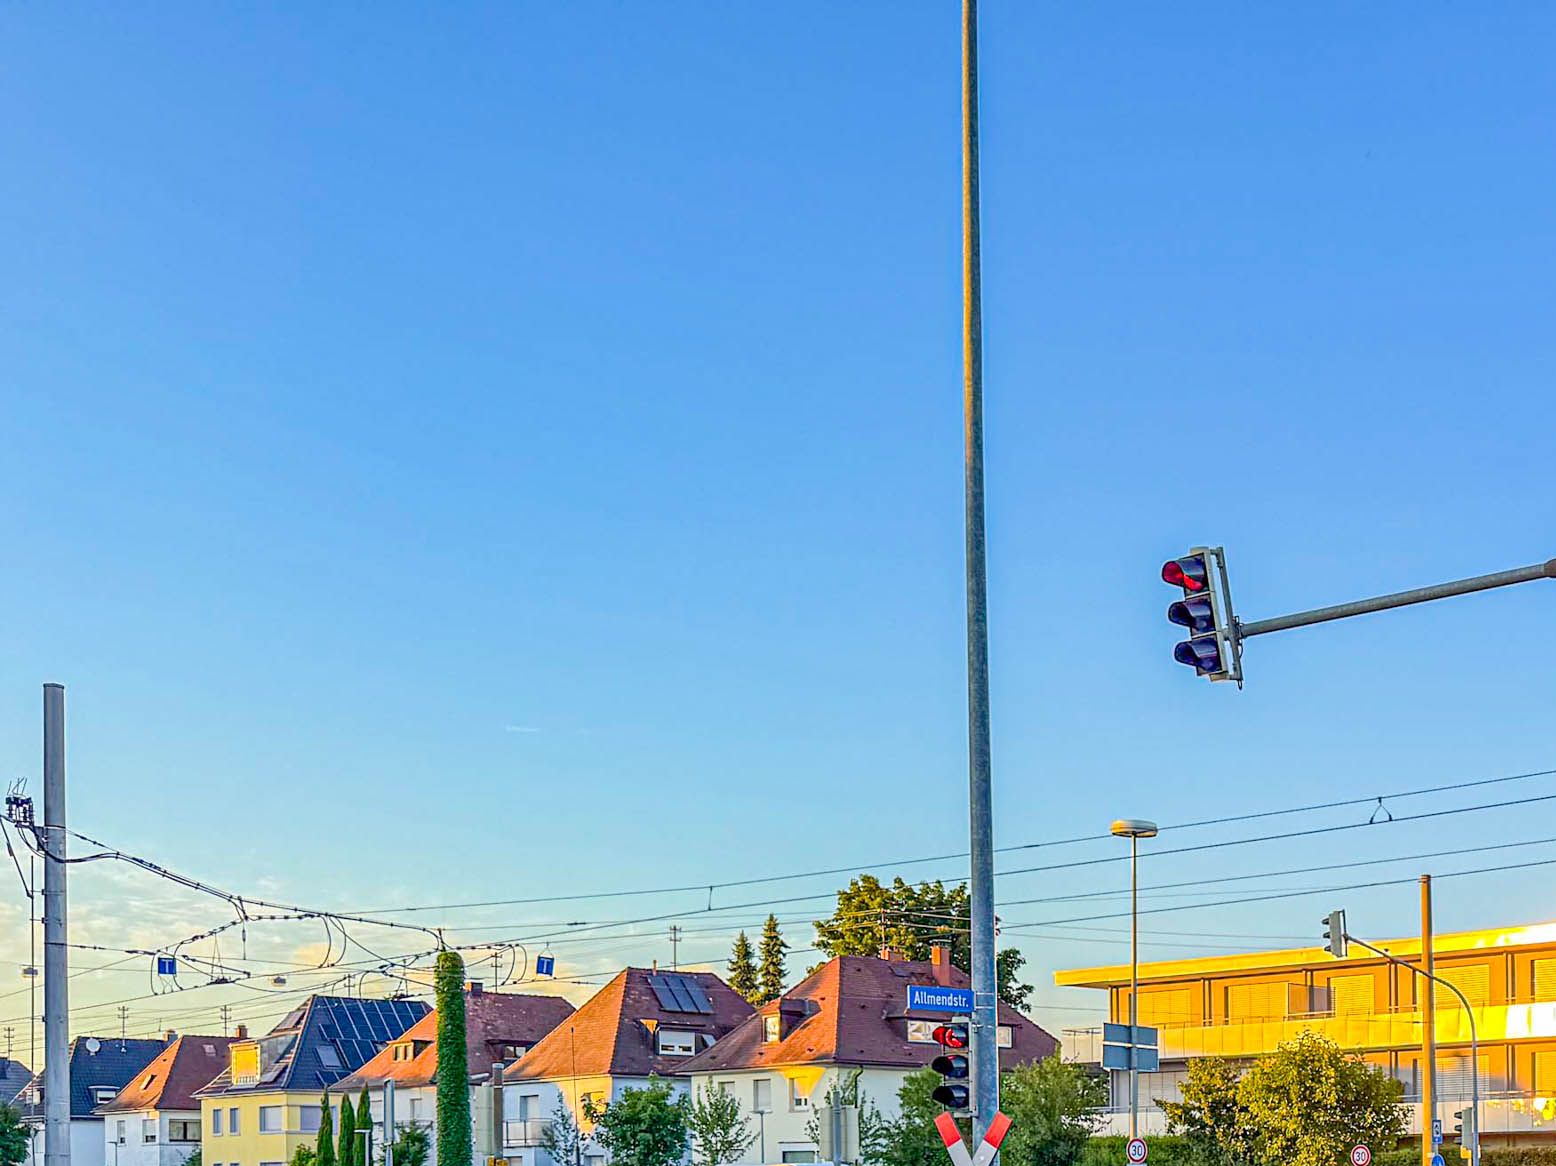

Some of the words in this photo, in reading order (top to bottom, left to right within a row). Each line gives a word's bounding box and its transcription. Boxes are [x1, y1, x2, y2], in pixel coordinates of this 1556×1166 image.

[913, 990, 969, 1008] Allmendstr.
[1132, 1145, 1143, 1156] 30
[1355, 1151, 1367, 1162] 30
